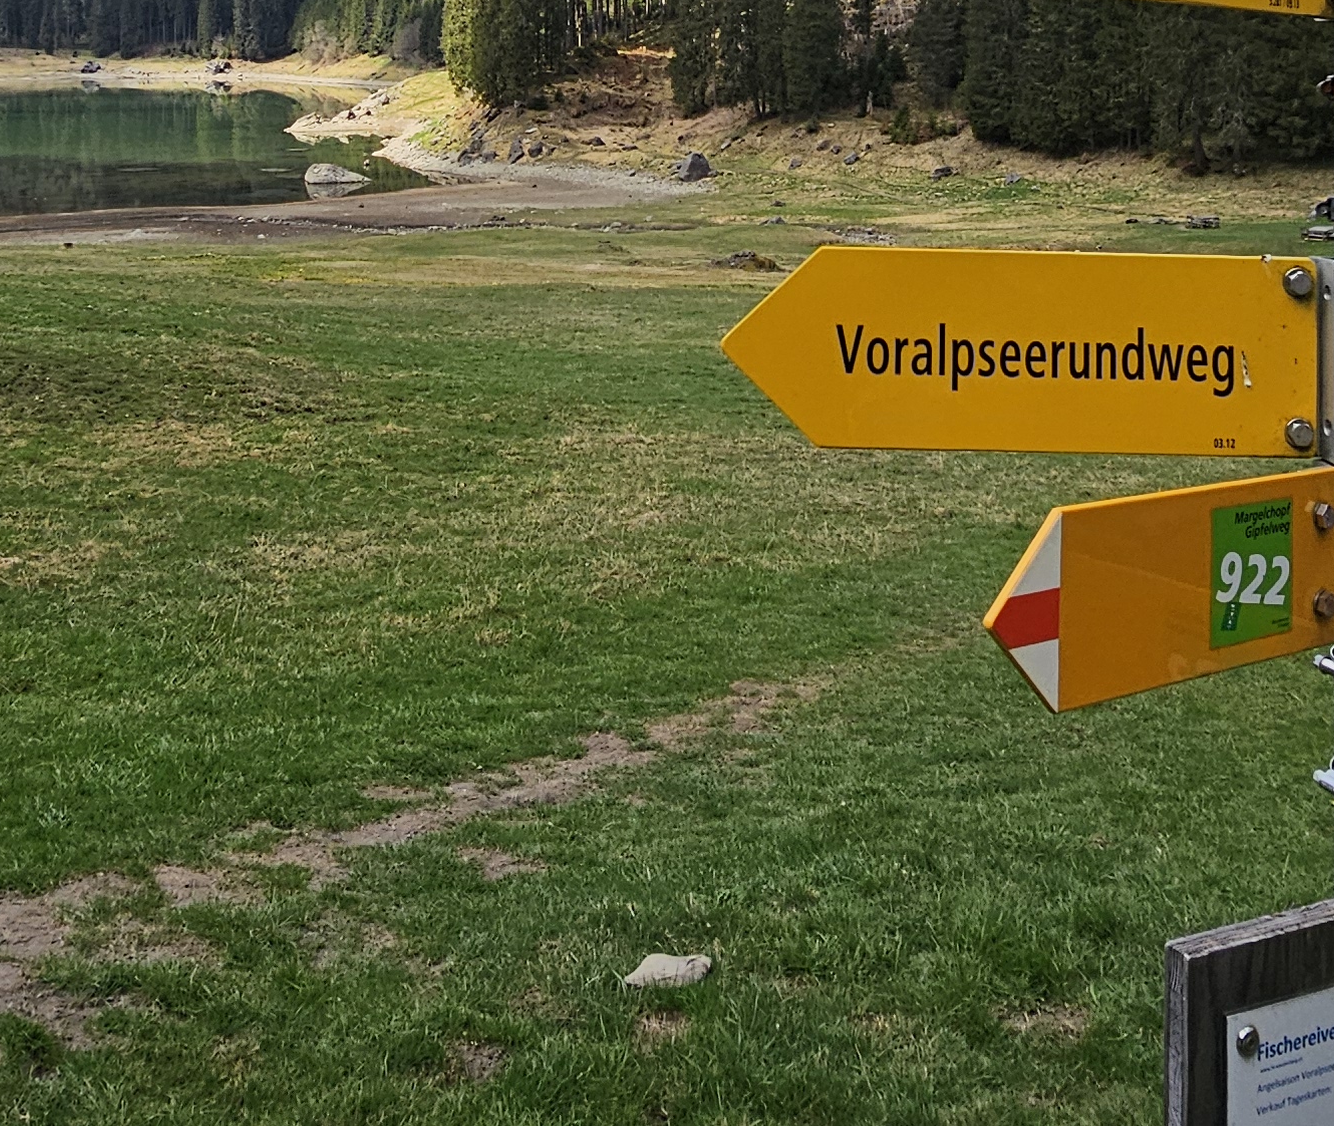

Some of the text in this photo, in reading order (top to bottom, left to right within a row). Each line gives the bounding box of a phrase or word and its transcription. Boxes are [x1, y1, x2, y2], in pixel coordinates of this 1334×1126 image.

[835, 323, 1236, 397] Voralpseerundweg
[1213, 437, 1236, 449] 03.12
[1234, 502, 1291, 526] Margelchopf
[1245, 521, 1290, 539] Gipfelweg
[1215, 551, 1290, 605] 922
